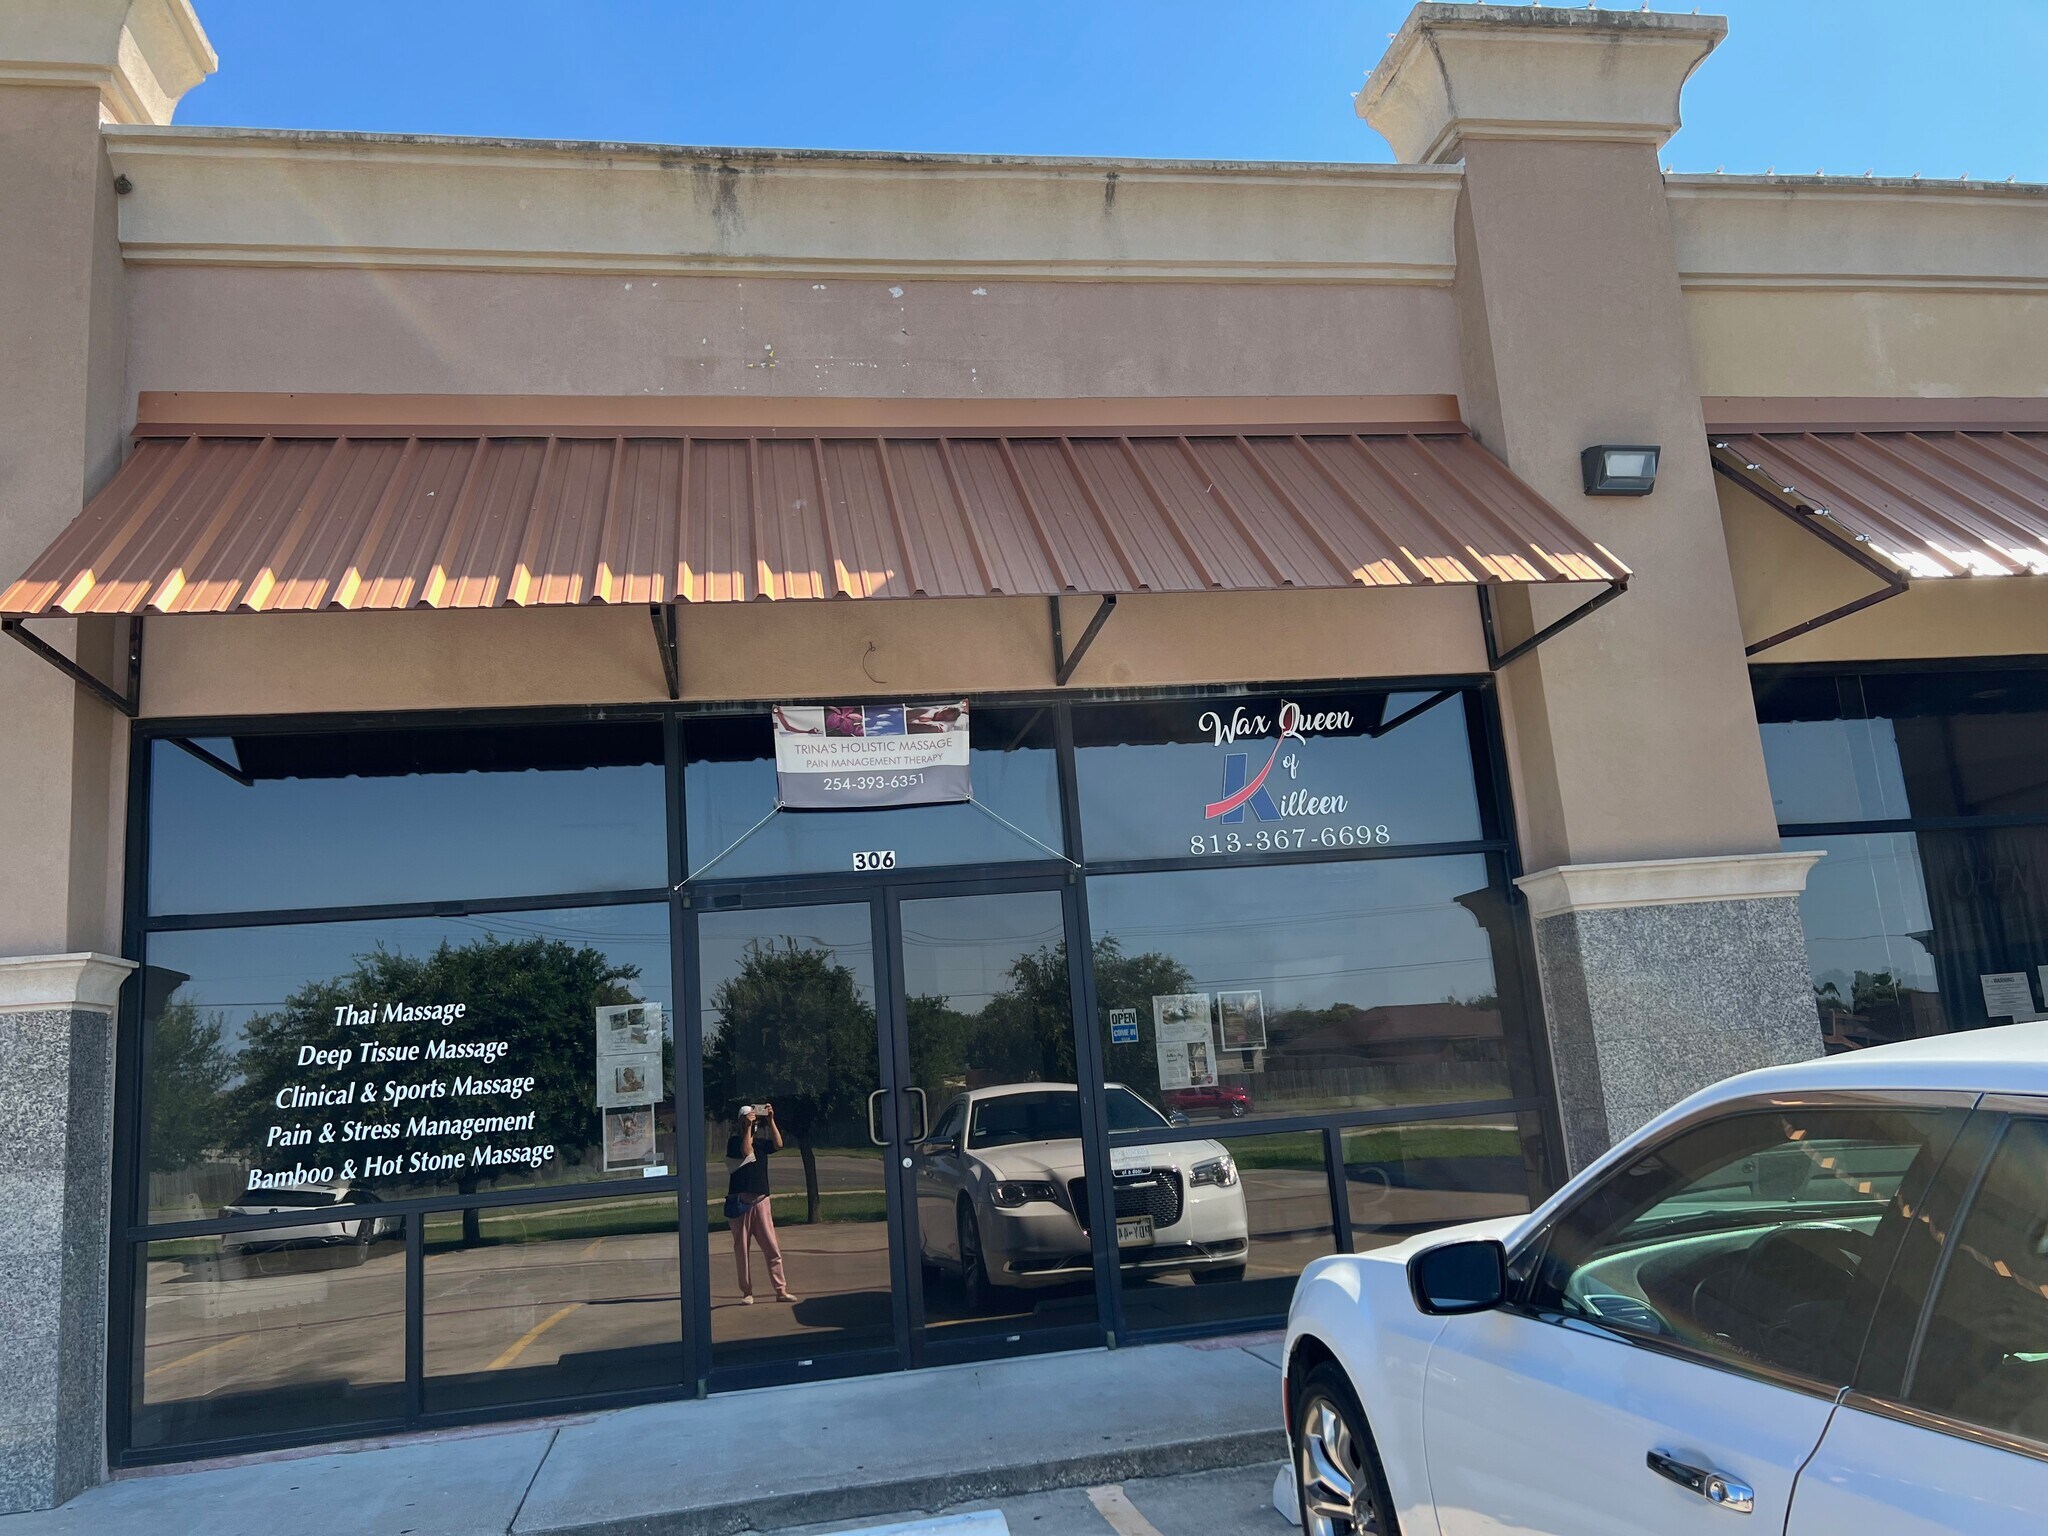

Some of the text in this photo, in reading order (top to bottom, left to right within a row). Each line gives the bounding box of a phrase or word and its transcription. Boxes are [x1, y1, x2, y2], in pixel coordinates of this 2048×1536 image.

[1198, 702, 1354, 747] Wax Queen
[795, 737, 953, 755] TRINA'S HOLISTIC MASSAGE
[806, 753, 943, 768] PAIN MANAGEMENT THERAPY
[1282, 753, 1299, 779] of
[823, 773, 925, 791] 254-393-6351
[1190, 824, 1391, 855] 813-367-6698
[855, 851, 894, 870] 306
[334, 1000, 466, 1026] Thai Massage
[1111, 1012, 1136, 1024] OPEN
[1113, 1028, 1136, 1037] COME IN
[297, 1039, 509, 1070] Deep Tissue Massage
[276, 1074, 535, 1109] Clinical & Sports Massage
[267, 1110, 536, 1147] Pain & Stress Management
[247, 1144, 555, 1191] Bamboo & Hot Stone Massage
